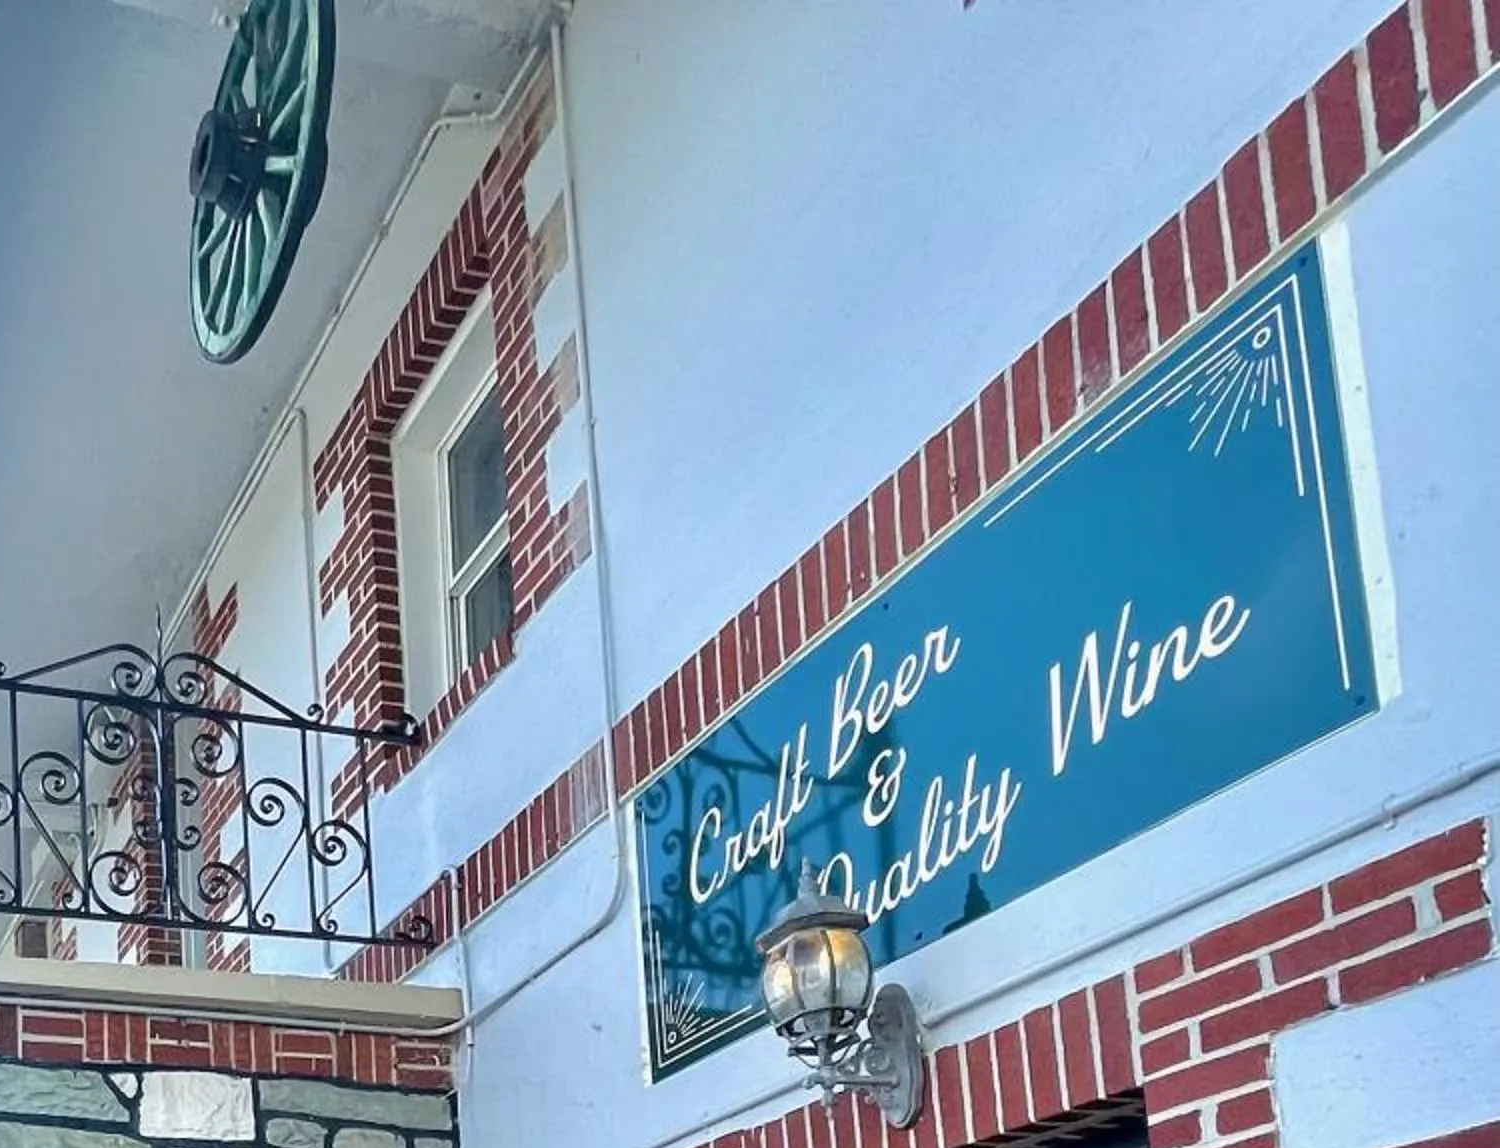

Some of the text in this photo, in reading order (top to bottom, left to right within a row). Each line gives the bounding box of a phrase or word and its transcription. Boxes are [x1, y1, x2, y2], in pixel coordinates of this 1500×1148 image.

[690, 625, 961, 903] Craft Beer
[1049, 595, 1250, 777] Wine
[863, 747, 906, 827] &
